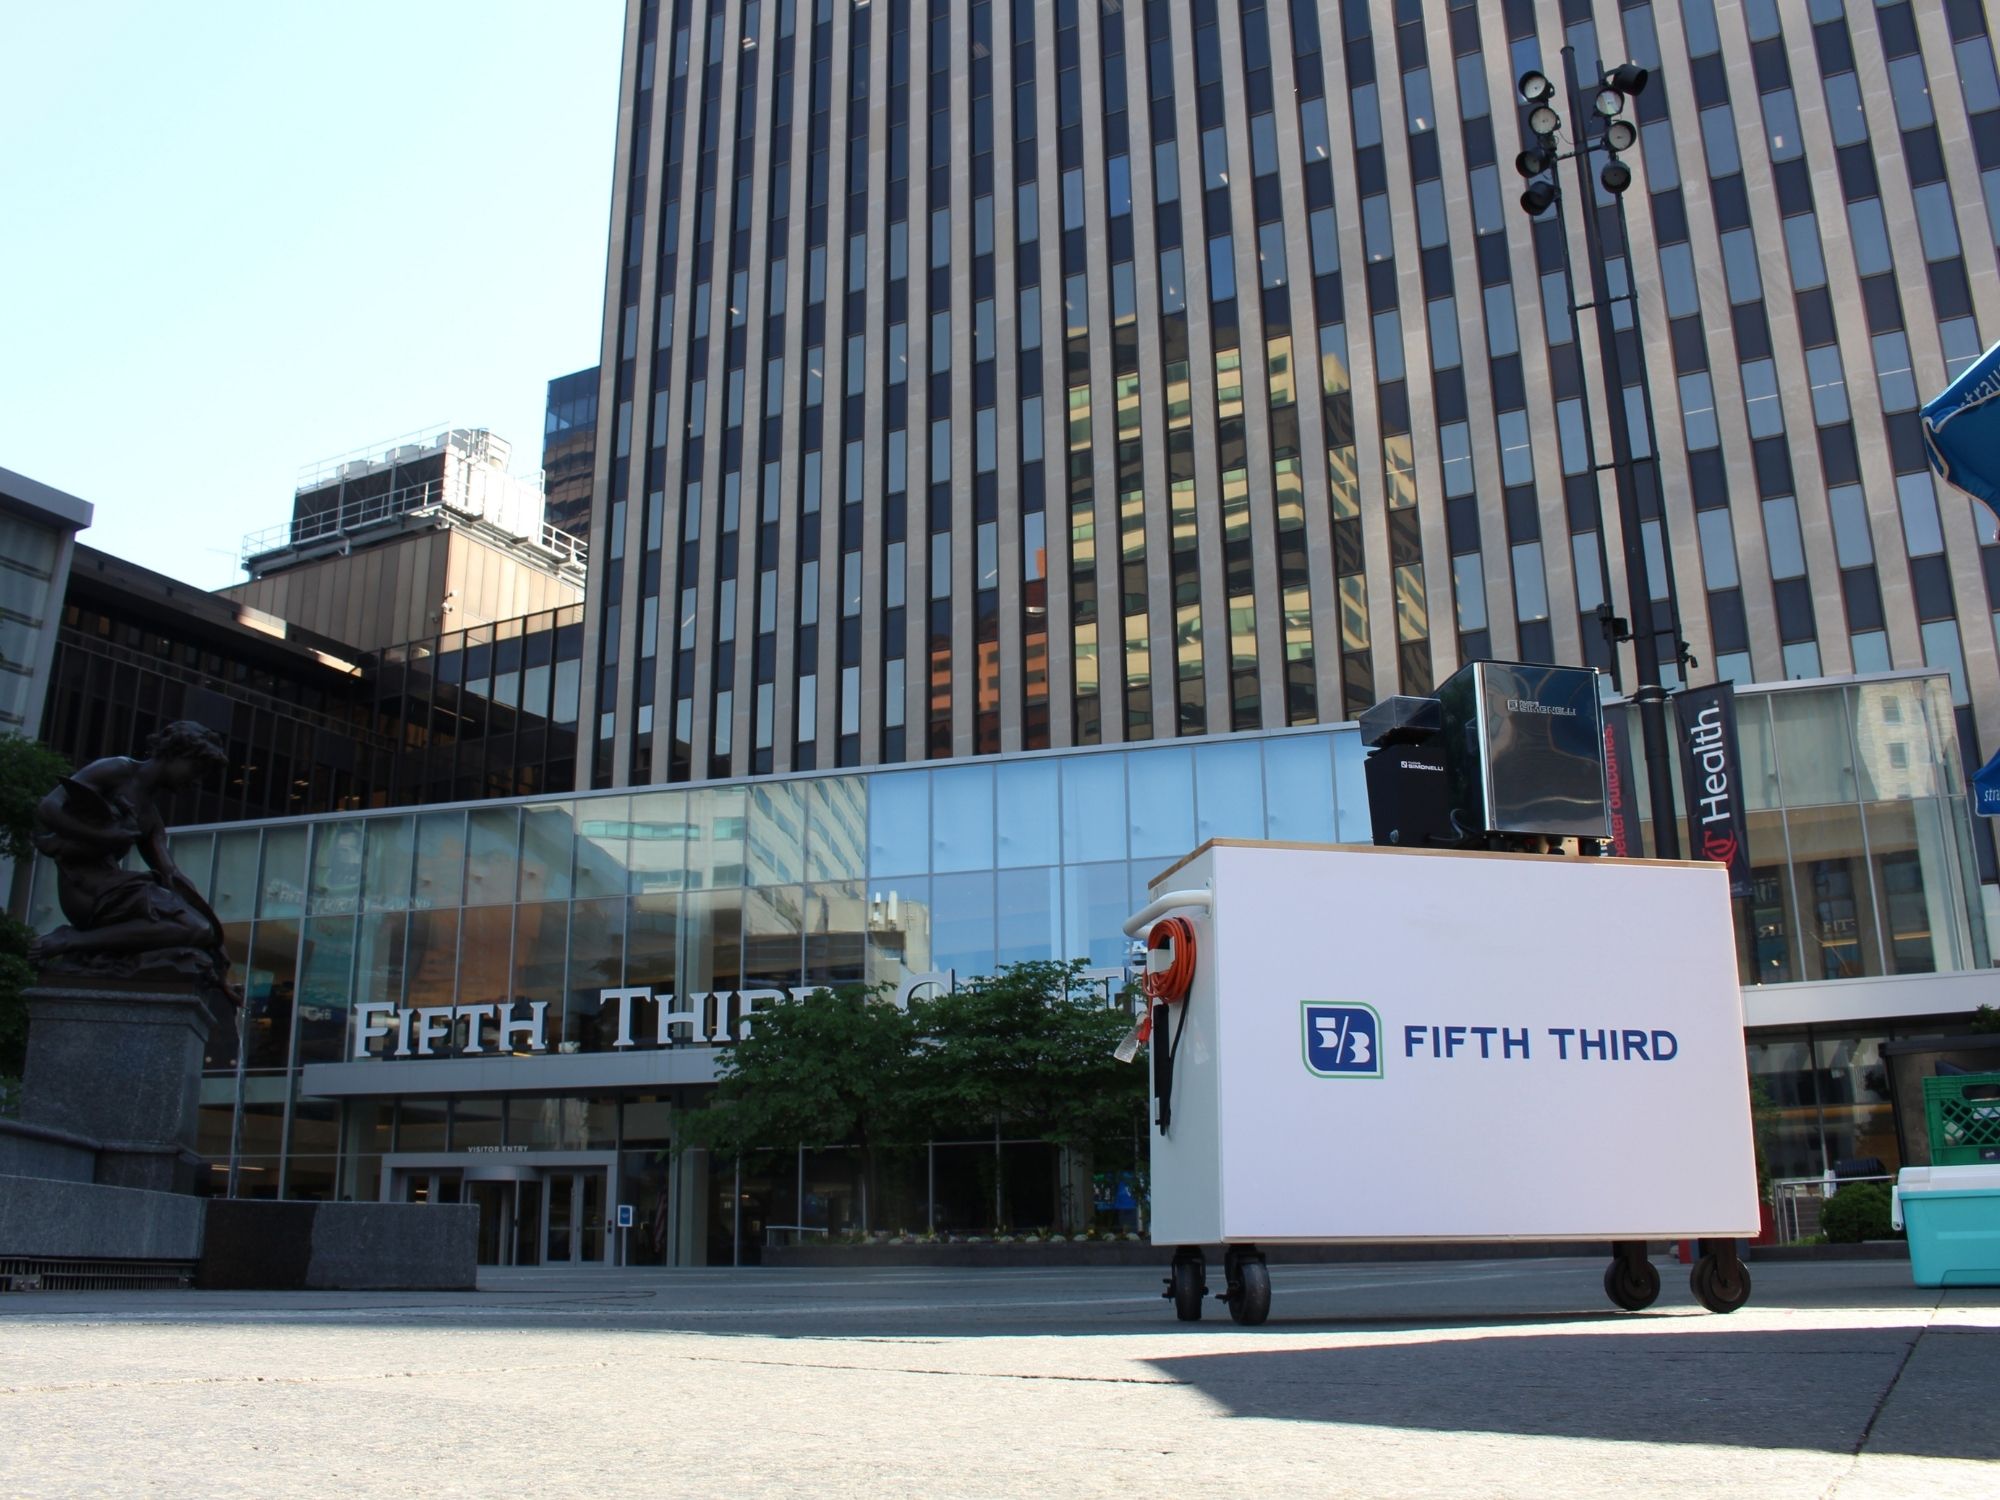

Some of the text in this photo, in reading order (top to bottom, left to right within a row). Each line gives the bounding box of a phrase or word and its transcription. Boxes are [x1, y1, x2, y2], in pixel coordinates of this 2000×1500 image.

[1408, 763, 1444, 772] SIMONELLI
[354, 1001, 549, 1057] FIFTH
[600, 986, 834, 1047] THIR
[1404, 1025, 1679, 1062] FIFTH THIRD
[468, 1145, 529, 1153] VISITOR ENTRY
